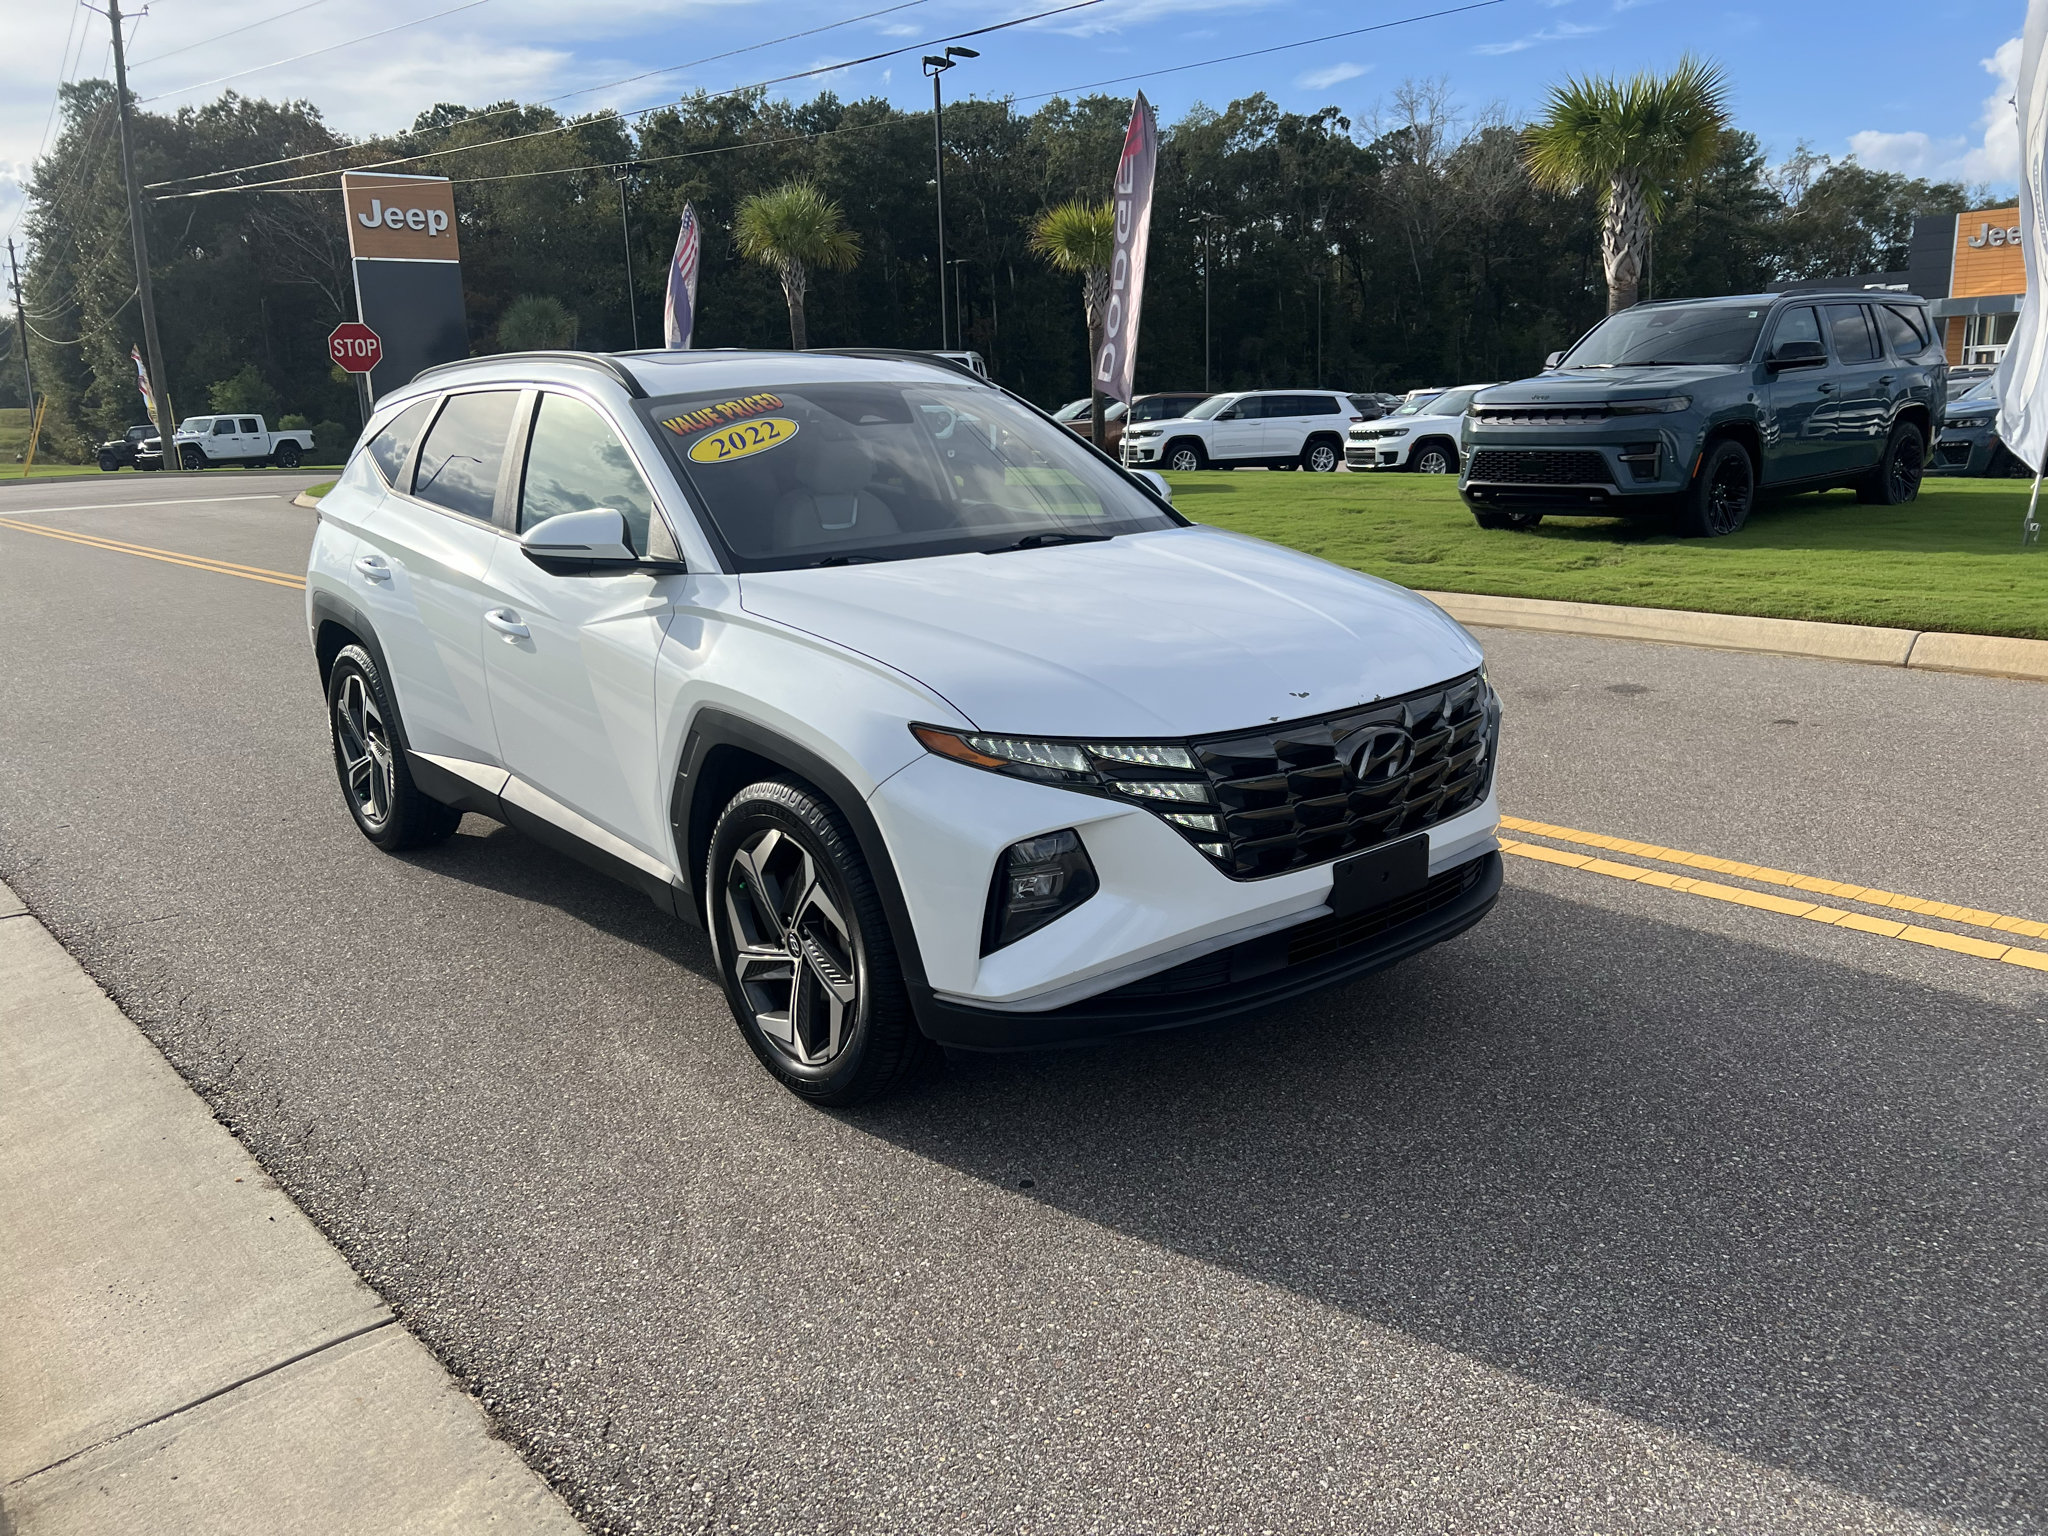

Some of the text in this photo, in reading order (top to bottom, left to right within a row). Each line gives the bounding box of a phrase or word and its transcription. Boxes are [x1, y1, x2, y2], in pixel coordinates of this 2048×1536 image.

[358, 199, 449, 237] Jeep
[1968, 223, 2021, 248] Jee
[1097, 154, 1134, 382] DODGE
[333, 338, 377, 357] STOP
[662, 392, 784, 436] VALUE PRICED
[710, 421, 781, 458] 2022
